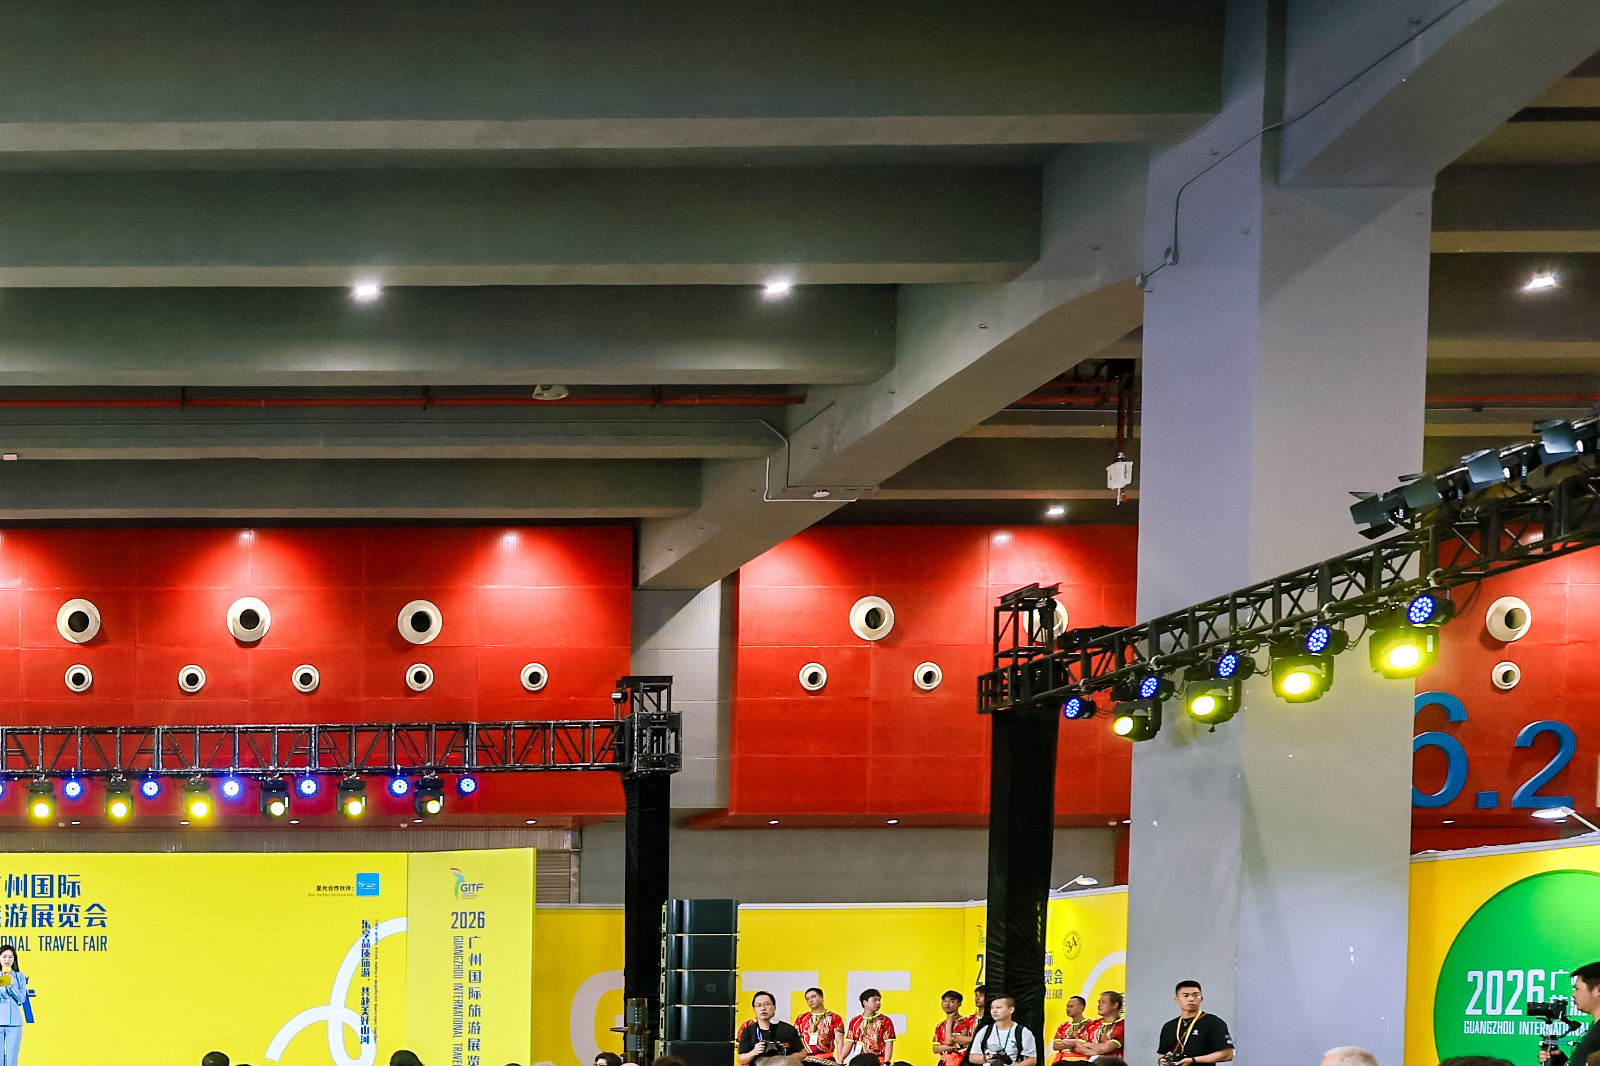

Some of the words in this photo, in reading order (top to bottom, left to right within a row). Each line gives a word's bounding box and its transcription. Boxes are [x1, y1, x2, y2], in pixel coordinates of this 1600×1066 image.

[460, 883, 484, 892] GITF
[451, 911, 485, 930] 2026
[38, 935, 79, 952] TRAVEL
[83, 935, 108, 952] FAIR
[453, 935, 464, 979] GUANGZHOU
[1465, 969, 1546, 1016] 2026
[453, 983, 464, 1039] INTERNATIONAL
[1464, 1020, 1515, 1035] GUANGZHOU
